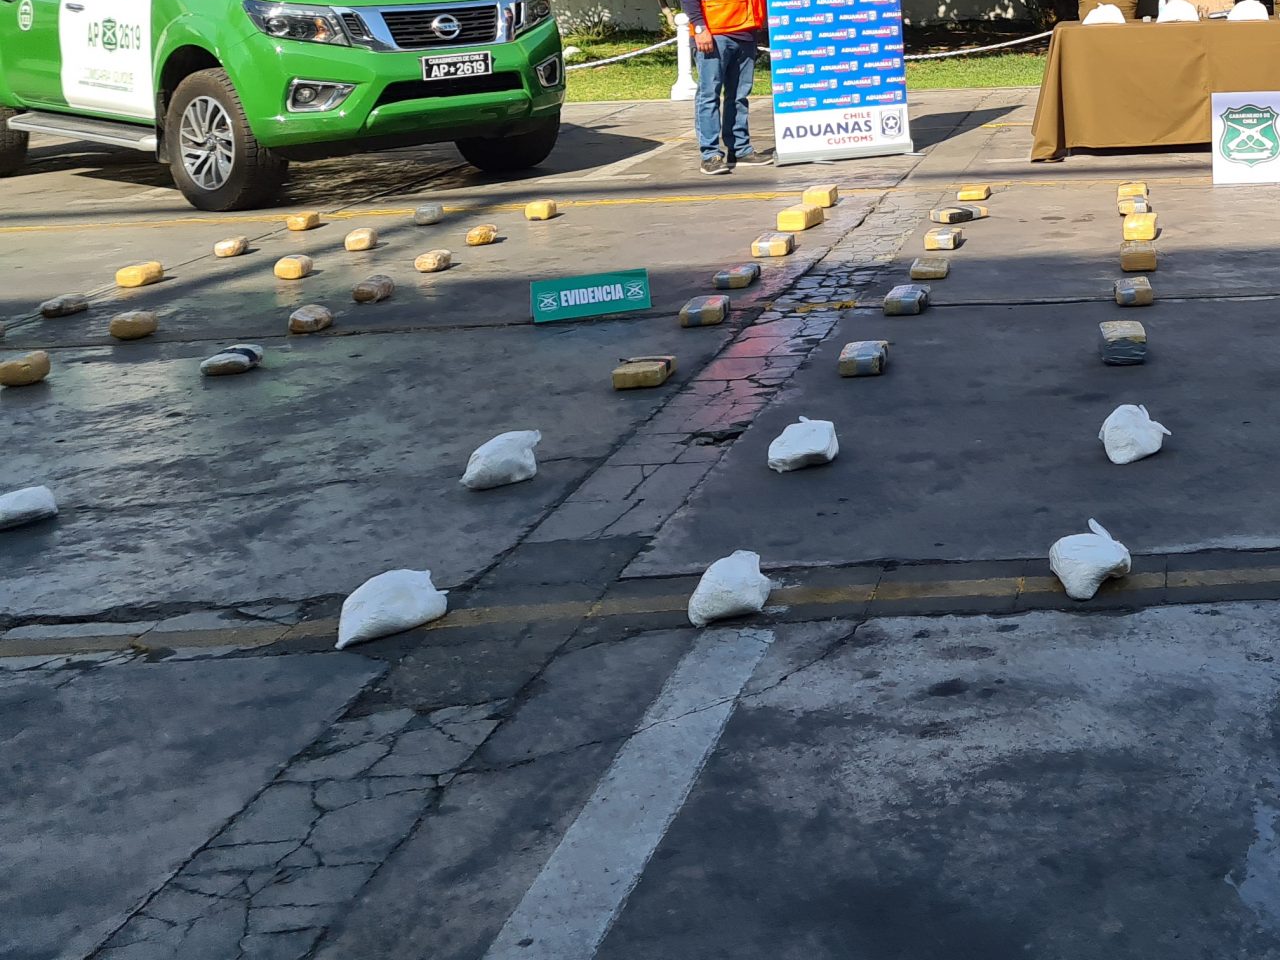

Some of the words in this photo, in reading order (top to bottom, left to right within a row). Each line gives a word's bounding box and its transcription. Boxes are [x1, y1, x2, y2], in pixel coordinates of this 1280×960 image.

[88, 22, 99, 47] AP
[119, 24, 140, 50] 2619
[431, 64, 448, 78] AP
[456, 61, 485, 75] 2619
[843, 112, 872, 120] CHILE
[782, 120, 872, 139] ADUANAS
[828, 135, 873, 145] CUSTOMS
[560, 283, 624, 307] EVIDENCIA
